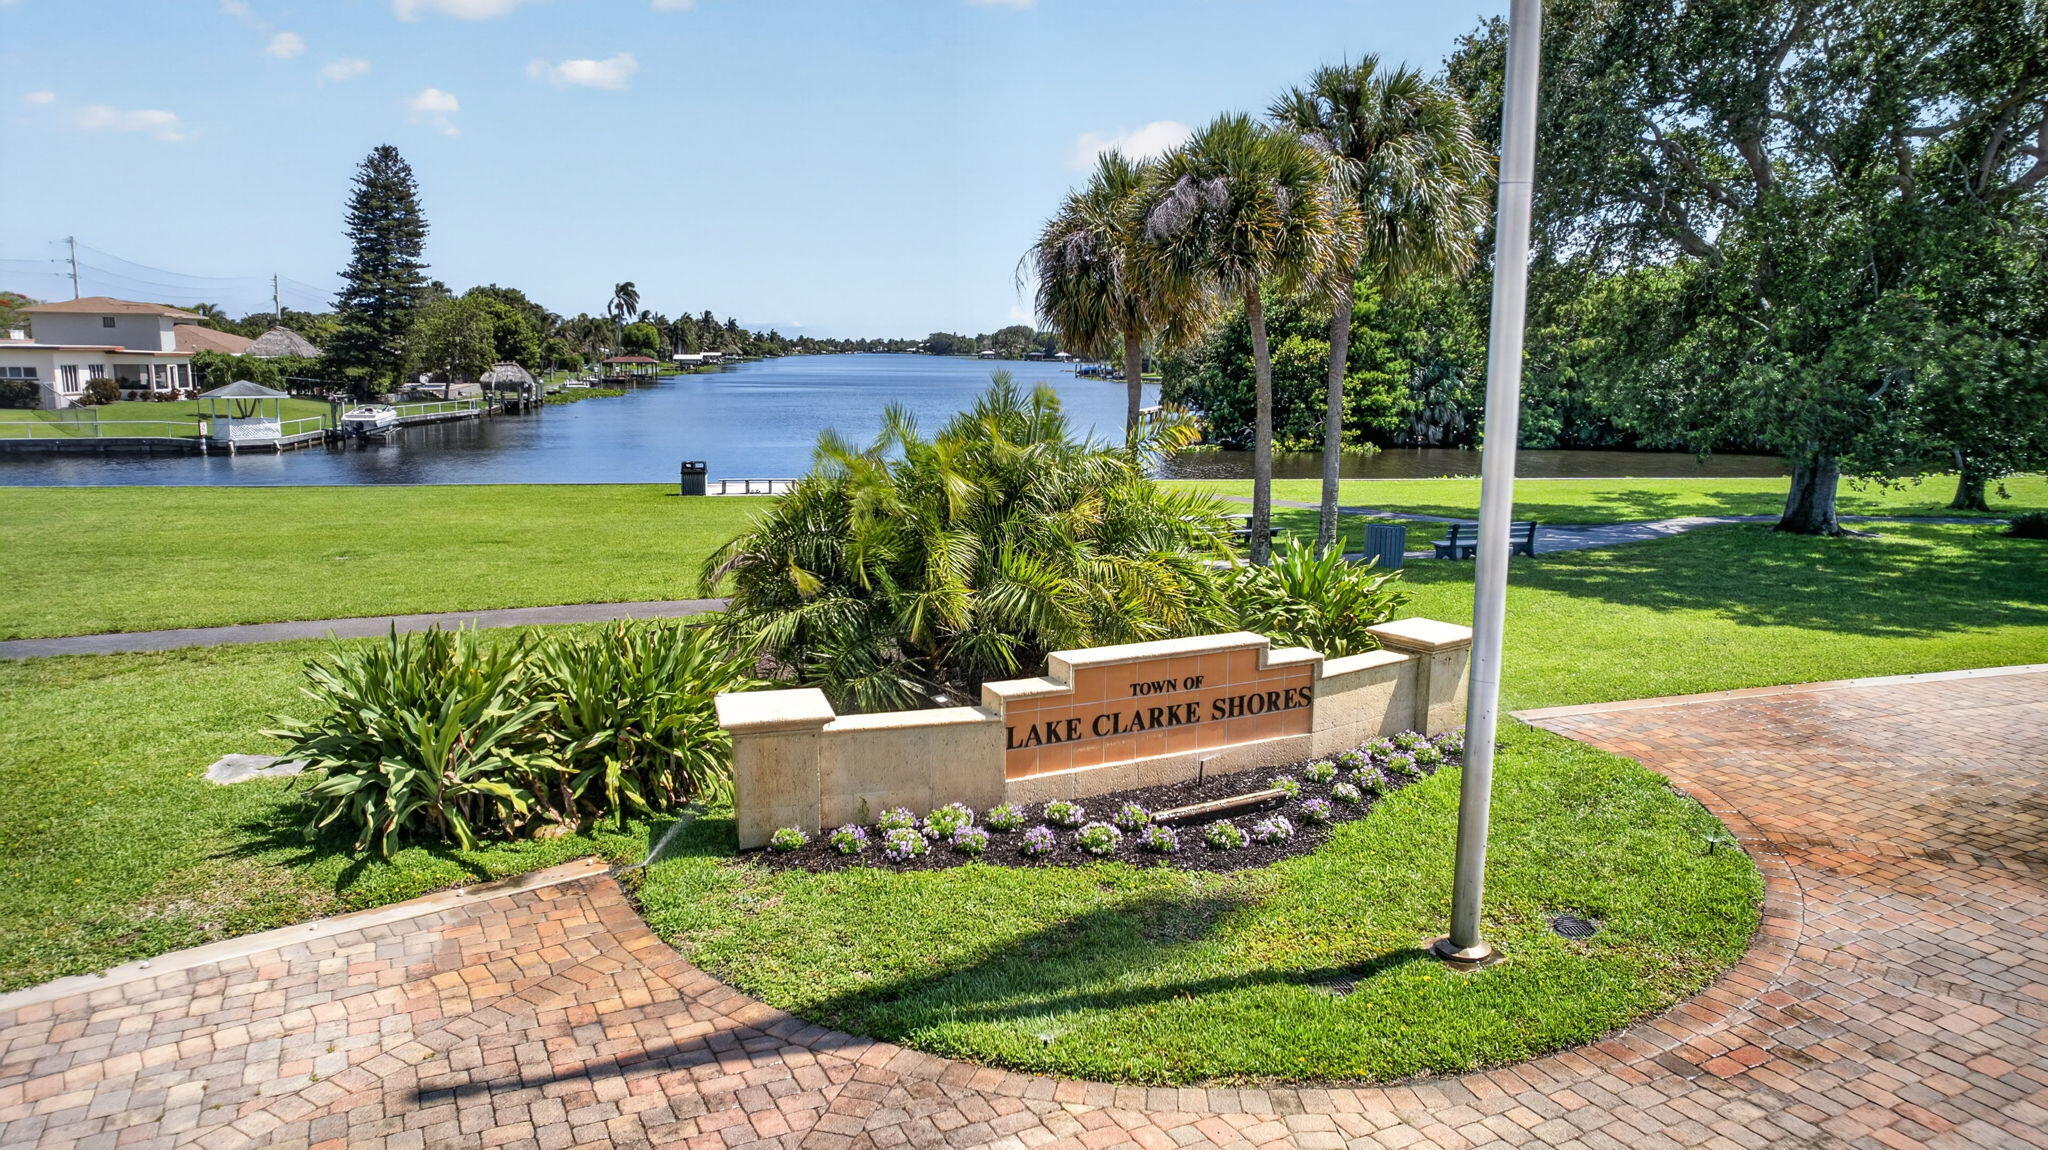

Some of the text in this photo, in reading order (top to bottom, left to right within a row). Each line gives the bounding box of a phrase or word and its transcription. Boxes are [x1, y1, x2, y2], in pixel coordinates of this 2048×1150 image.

[1130, 675, 1204, 696] TOWN OF
[1006, 686, 1313, 750] LAKE CLARKE SHORES
